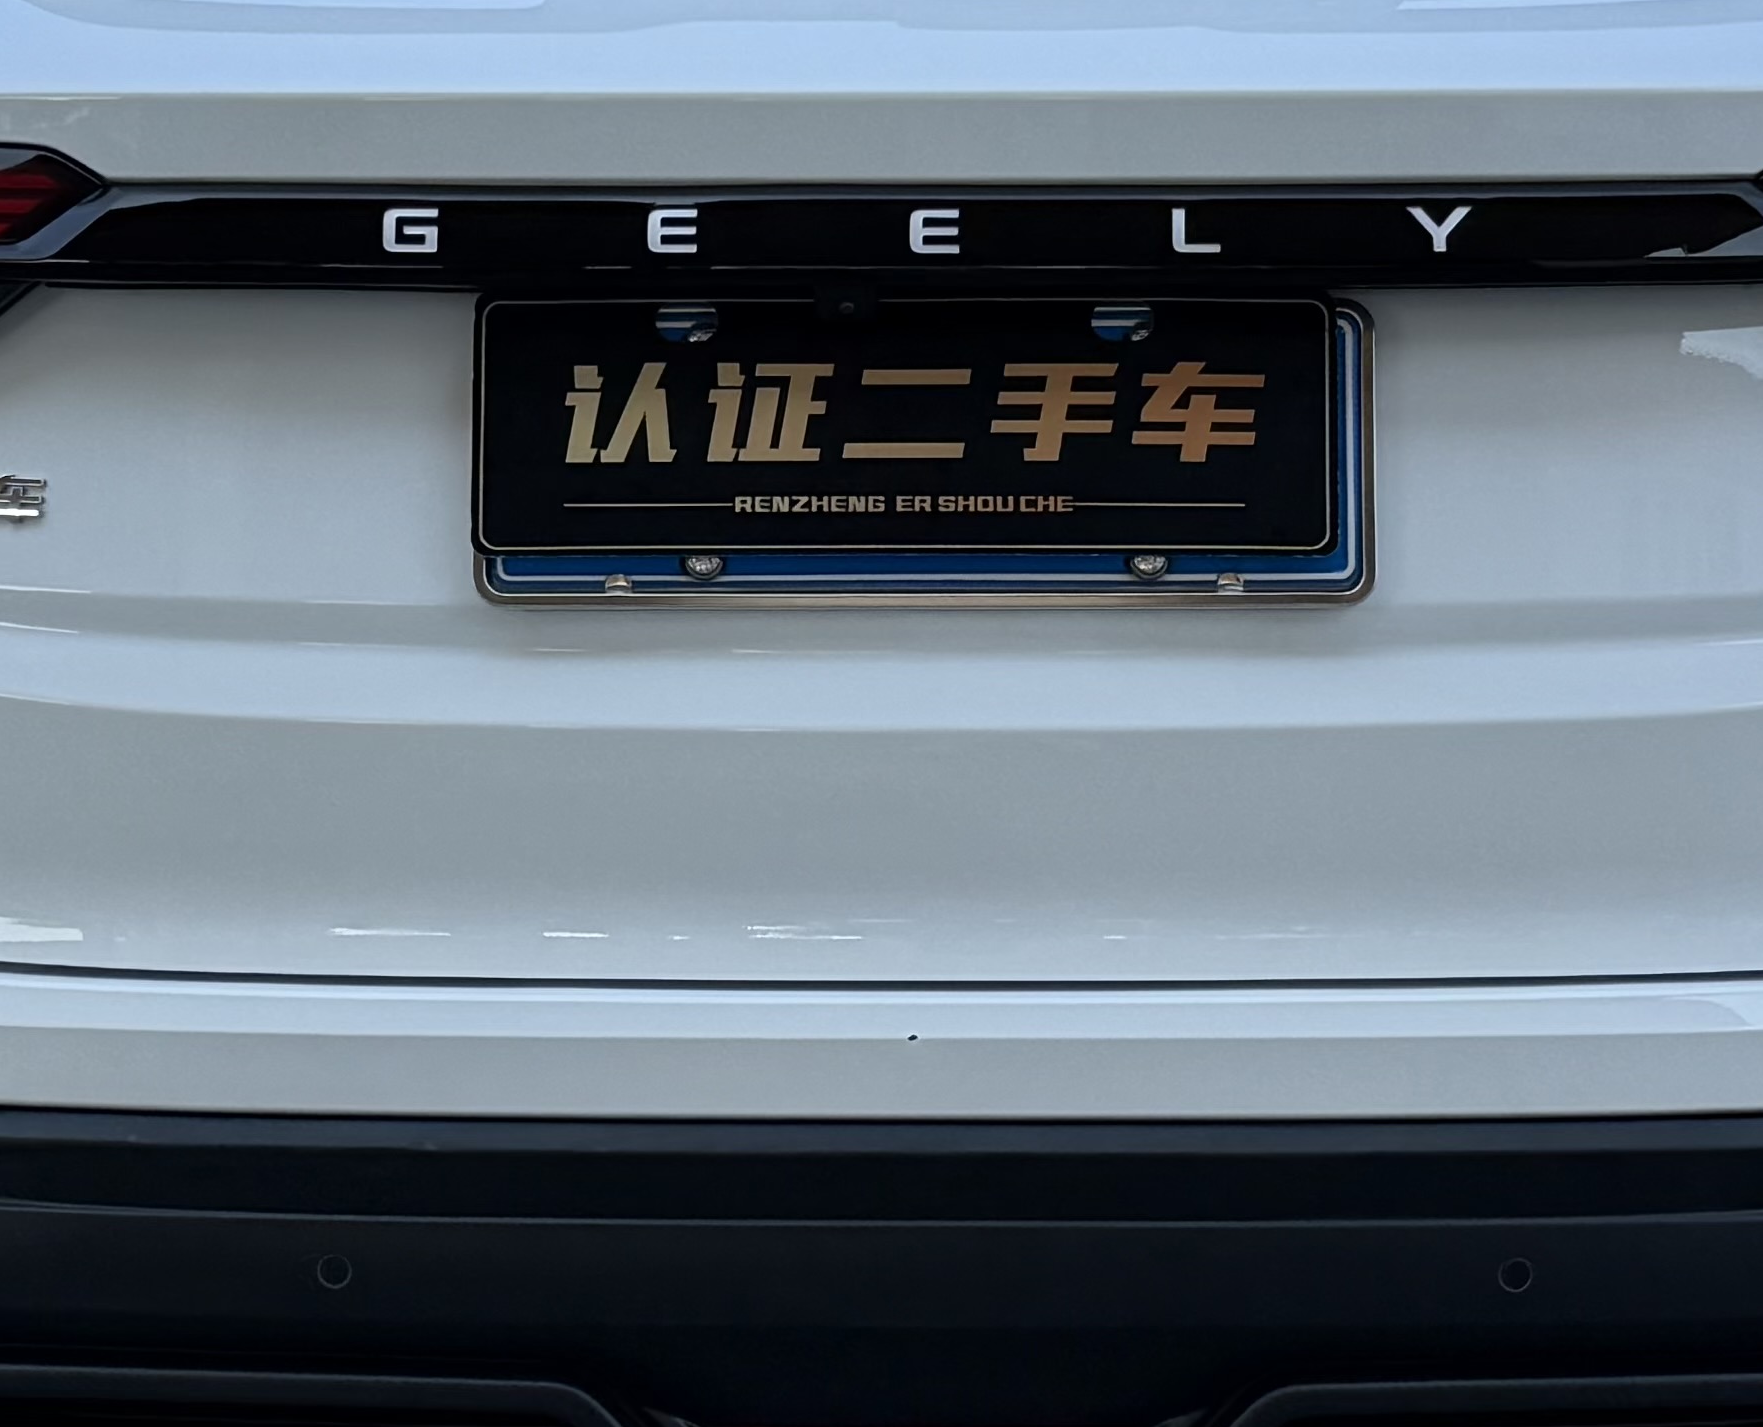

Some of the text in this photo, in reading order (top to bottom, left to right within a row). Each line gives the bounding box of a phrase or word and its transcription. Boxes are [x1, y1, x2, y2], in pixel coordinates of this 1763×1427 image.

[381, 206, 1472, 255] GEELY
[563, 361, 1267, 464] 认证二手车
[734, 495, 1075, 514] RENZHENG ER SHOU CHE
